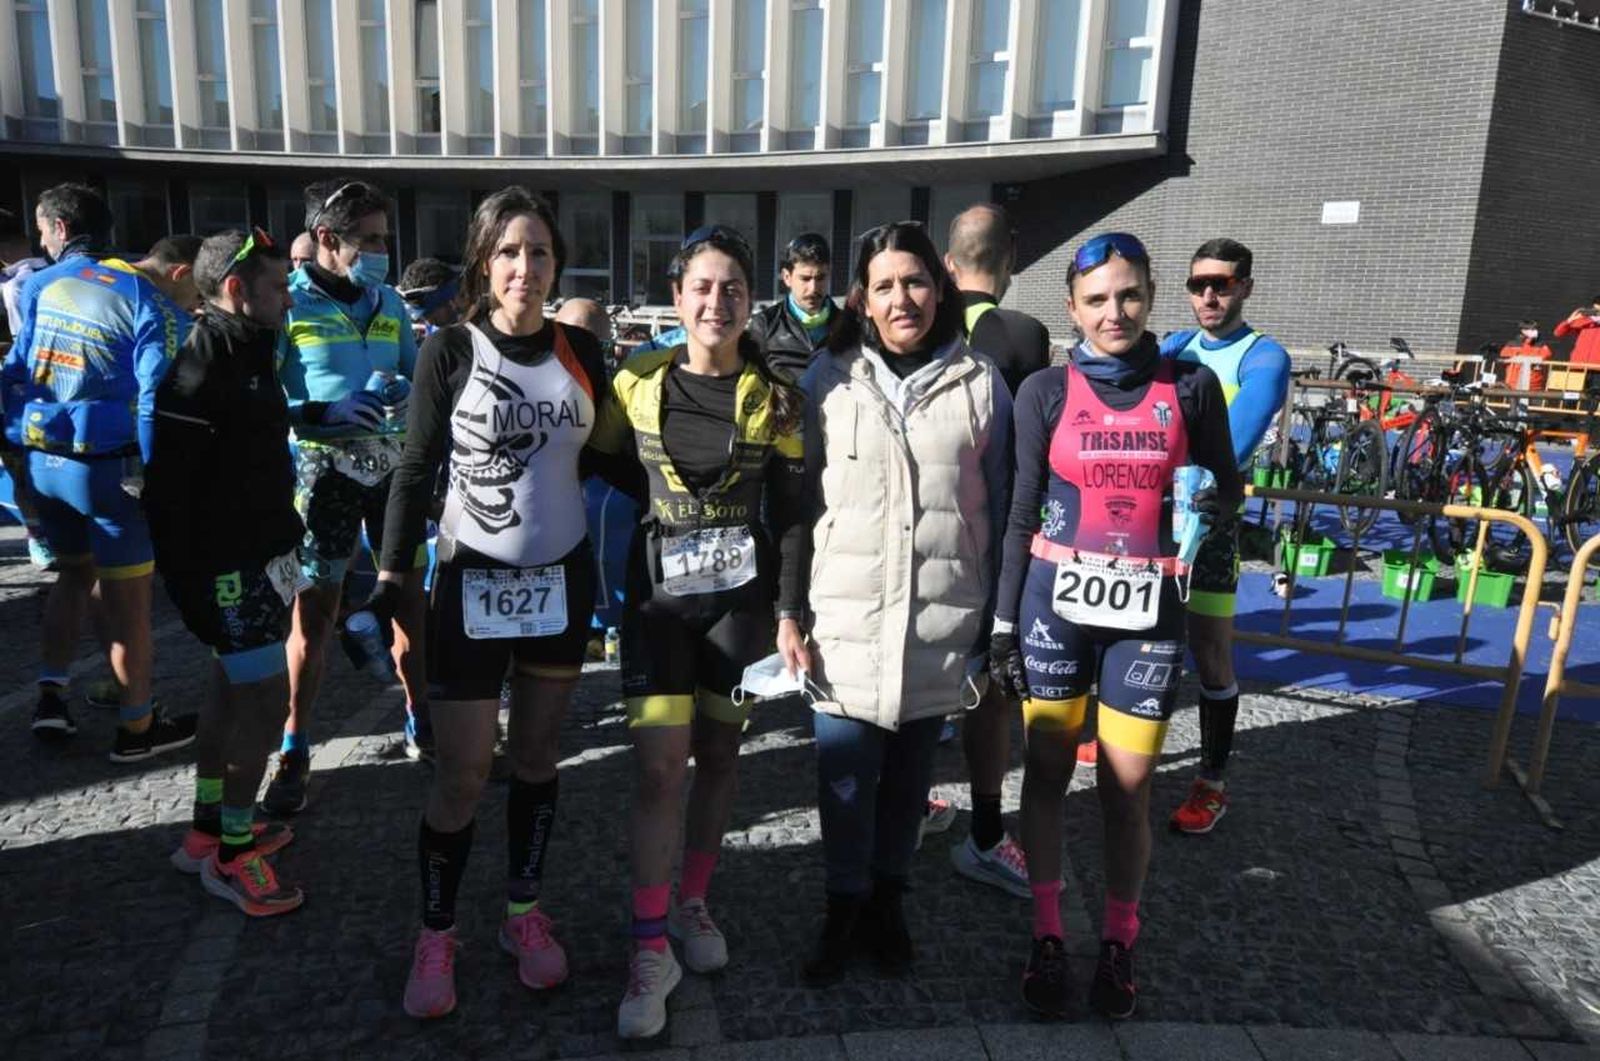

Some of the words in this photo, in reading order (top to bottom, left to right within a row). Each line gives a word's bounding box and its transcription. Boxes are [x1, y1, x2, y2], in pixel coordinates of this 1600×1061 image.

[492, 401, 587, 433] MORAL
[1083, 462, 1161, 490] LORENZO
[678, 503, 699, 519] EL
[677, 547, 743, 576] 1788
[479, 587, 551, 617] 1627
[1056, 571, 1155, 613] 2001
